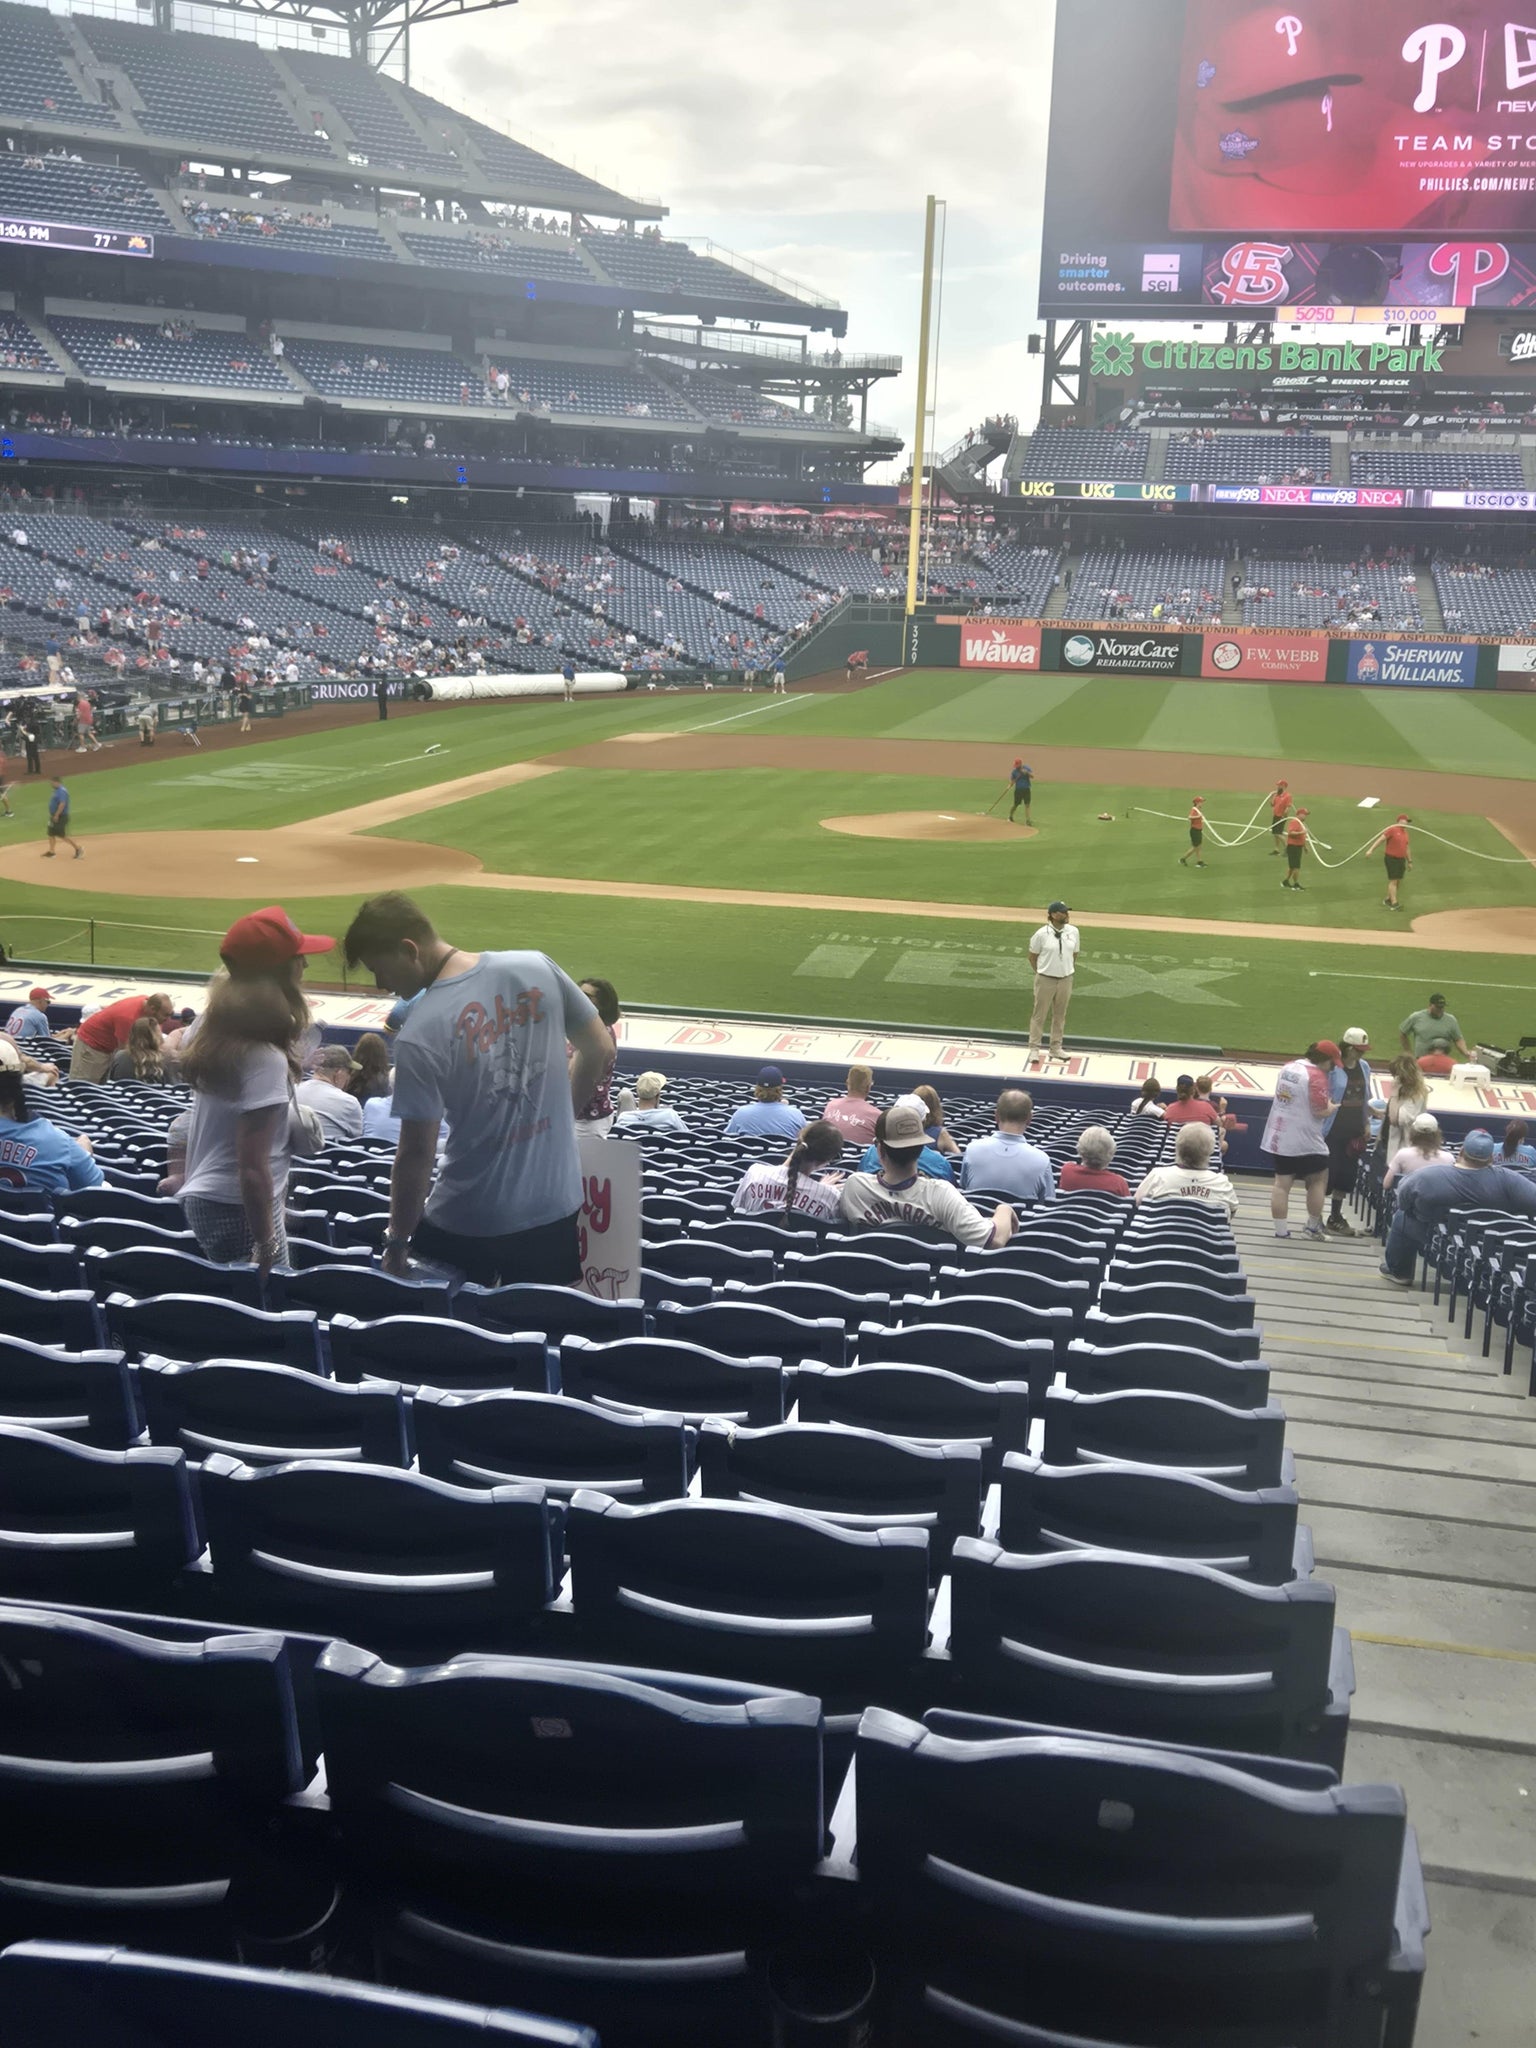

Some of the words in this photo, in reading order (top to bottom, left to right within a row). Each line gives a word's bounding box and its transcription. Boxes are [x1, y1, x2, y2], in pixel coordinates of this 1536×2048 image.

[1402, 23, 1466, 113] P
[1394, 135, 1473, 151] TEAM
[29, 226, 50, 241] PM
[1060, 253, 1107, 268] Driving
[1058, 268, 1110, 279] smarter
[1429, 243, 1510, 306] P
[1058, 281, 1126, 292] outcomes.
[1383, 309, 1437, 322] $10,000
[1510, 332, 1536, 359] GH
[1142, 339, 1273, 371] Citizens
[1279, 340, 1363, 372] Bank
[1368, 341, 1446, 373] Park
[1331, 378, 1377, 386] ENERGY
[1021, 481, 1055, 497] UKG
[1081, 483, 1115, 498] UKG
[1142, 484, 1176, 500] UKG
[1265, 489, 1306, 503] NECA
[1361, 491, 1402, 505] NECA
[1465, 495, 1528, 507] LISCIO'S
[964, 617, 1023, 626] ASPLUNDH
[1034, 619, 1094, 629] ASPLUNDH
[1106, 622, 1165, 632] ASPLUNDH
[1177, 625, 1238, 635] ASPLUNDH
[1250, 628, 1312, 638] ASPLUNDH
[1324, 631, 1386, 641] ASPLUNDH
[1399, 634, 1462, 643] ASPLUNDH
[911, 625, 919, 664] 329
[965, 639, 1036, 663] Wawa
[1096, 638, 1179, 658] NovaCare
[1246, 648, 1272, 661] F.W.
[1276, 649, 1320, 663] WEBB
[1384, 645, 1464, 665] SHERWIN
[1096, 659, 1176, 669] REHABILITATION
[1261, 661, 1302, 671] COMPANY
[1381, 663, 1461, 683] WILLIAMS
[311, 683, 369, 700] GRUNGO
[372, 682, 398, 698] LW
[456, 986, 546, 1065] Pabst
[1180, 1185, 1211, 1199] HARPER
